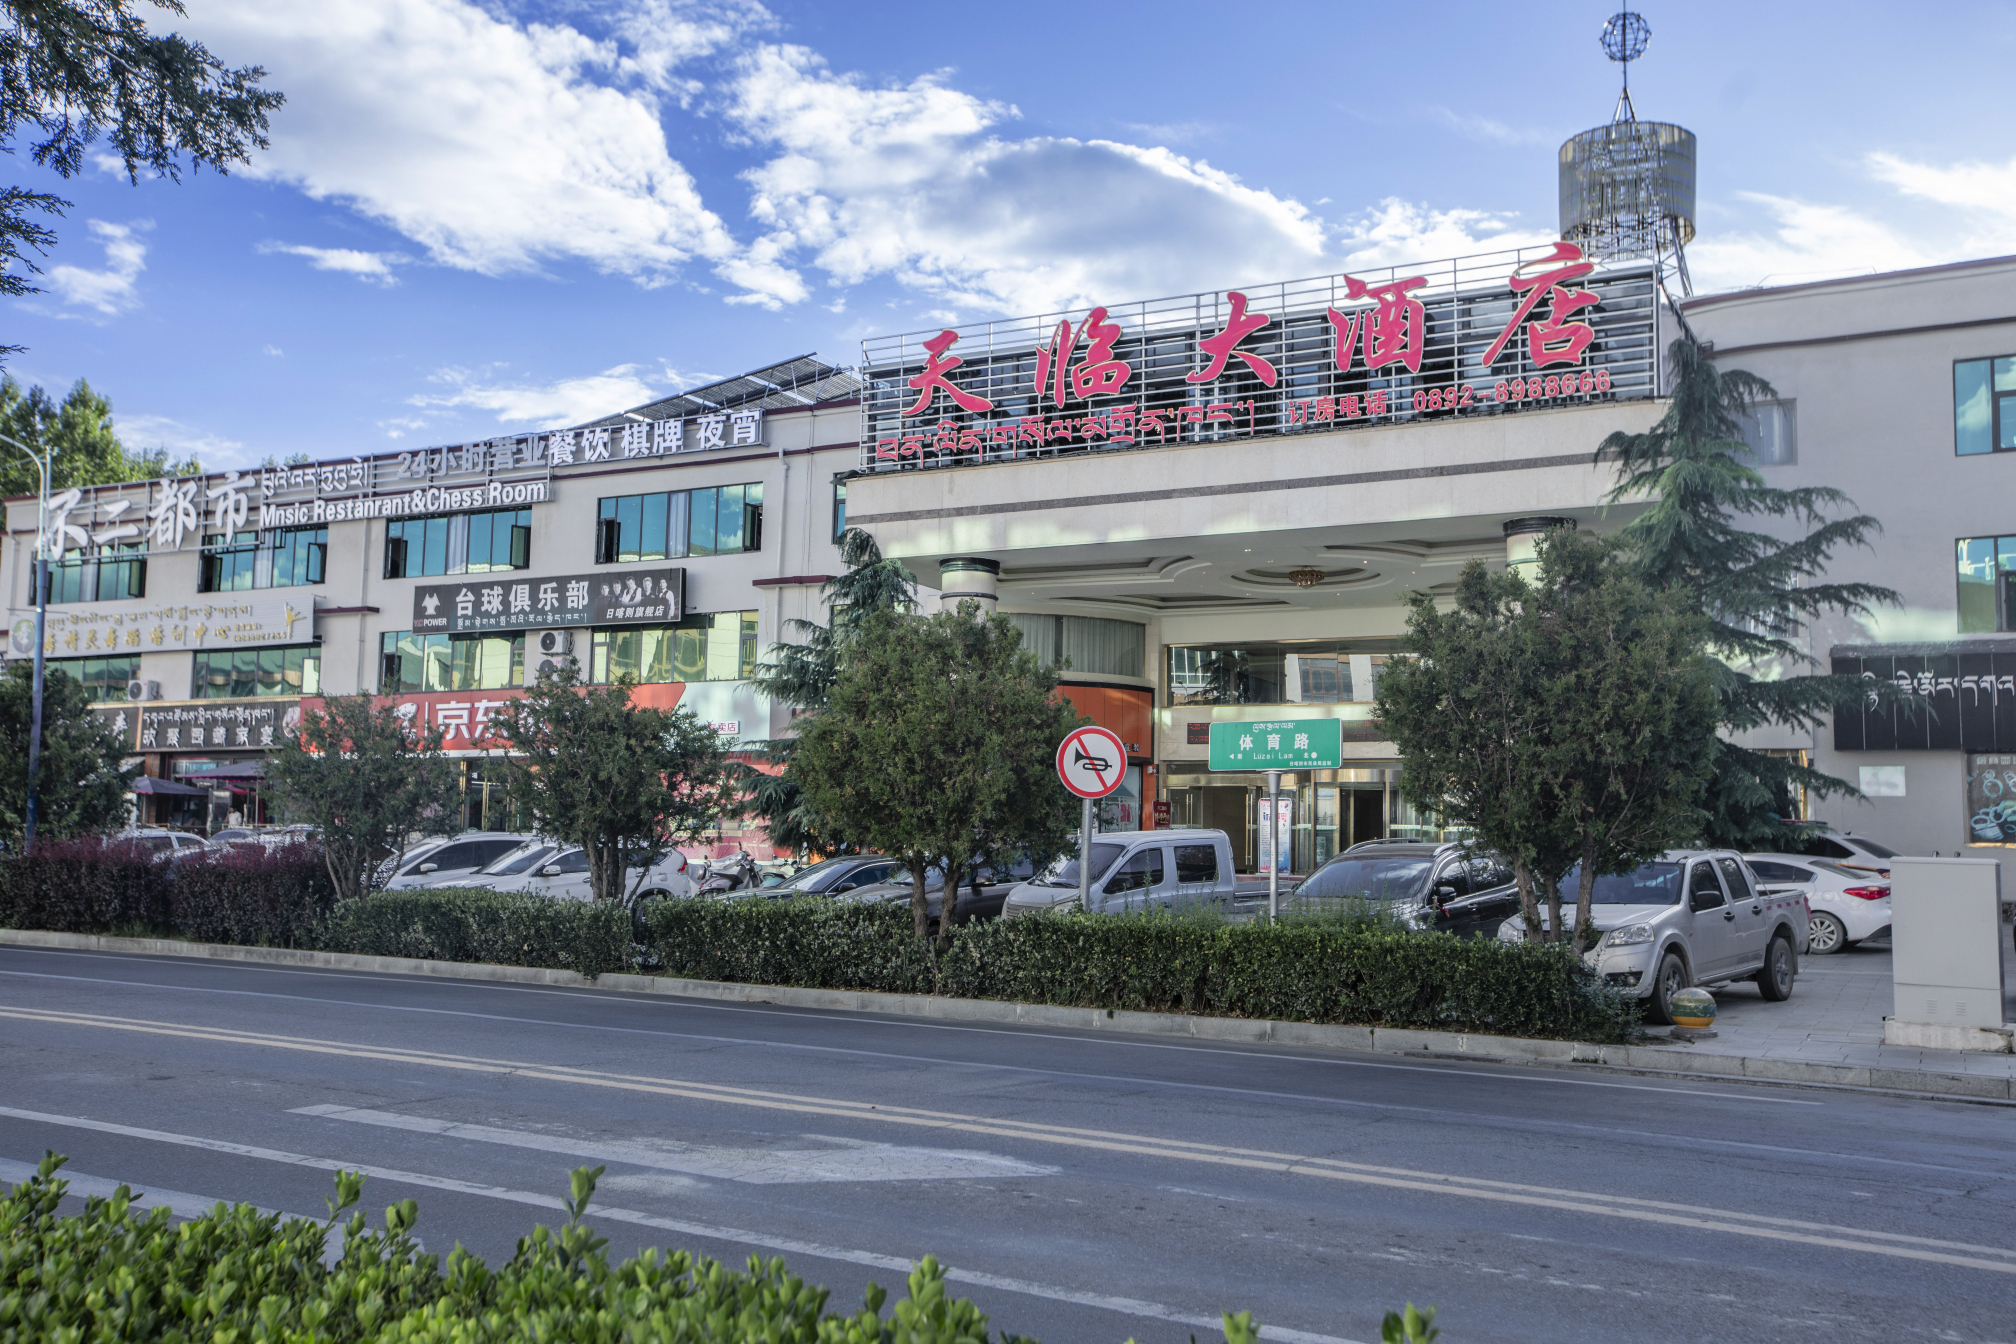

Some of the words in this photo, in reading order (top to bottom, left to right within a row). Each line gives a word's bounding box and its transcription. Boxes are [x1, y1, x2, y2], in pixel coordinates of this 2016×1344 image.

[902, 241, 1600, 416] 天临大酒店
[1287, 389, 1389, 424] 订房电话
[1412, 370, 1612, 411] 0892-8988666
[397, 434, 547, 479] 24小时营业
[548, 427, 611, 466] 餐饮
[620, 419, 683, 458] 棋牌
[696, 409, 761, 449] 夜宵
[488, 481, 546, 505] Room
[36, 471, 256, 561] 不二都市
[455, 580, 590, 618] 台球俱乐部
[606, 604, 665, 619] 日喀则旗舰店
[423, 617, 448, 627] POWER
[1238, 733, 1310, 751] 体育路
[1278, 751, 1294, 760] Lam
